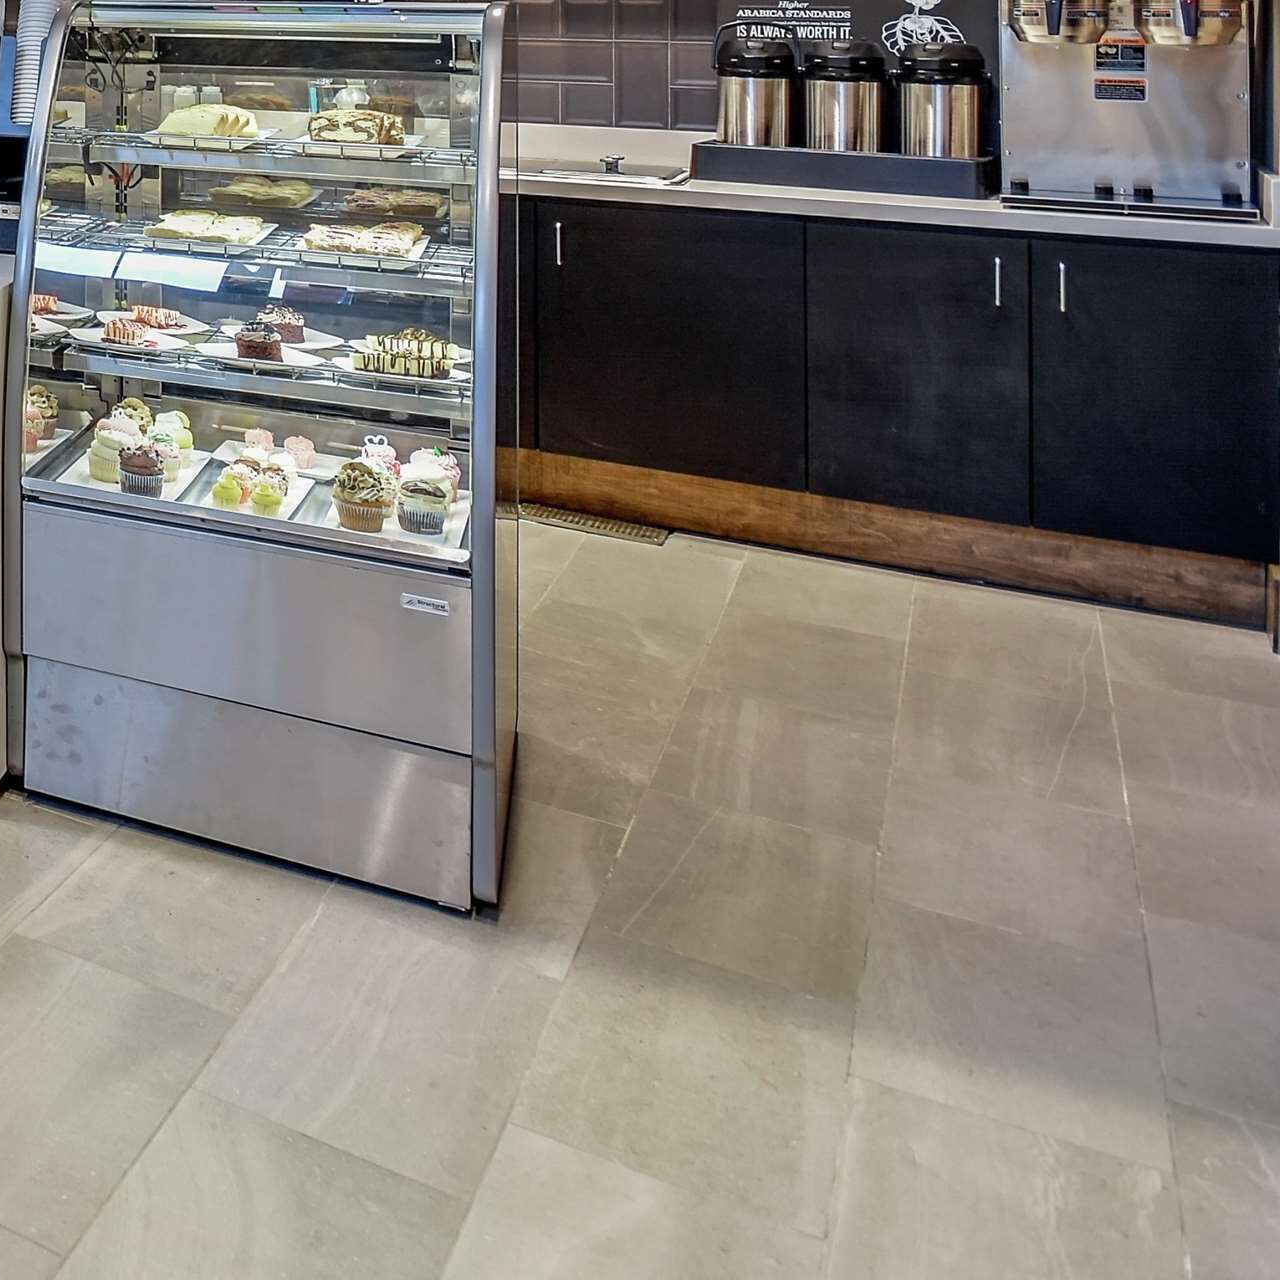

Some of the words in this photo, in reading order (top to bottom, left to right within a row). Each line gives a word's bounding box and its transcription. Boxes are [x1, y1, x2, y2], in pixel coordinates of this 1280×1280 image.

[777, 0, 810, 9] Higher
[736, 9, 784, 18] ARABICA
[785, 9, 851, 19] STANDARDS
[736, 24, 747, 37] IS
[796, 26, 837, 39] WORTH
[840, 27, 854, 40] IT.
